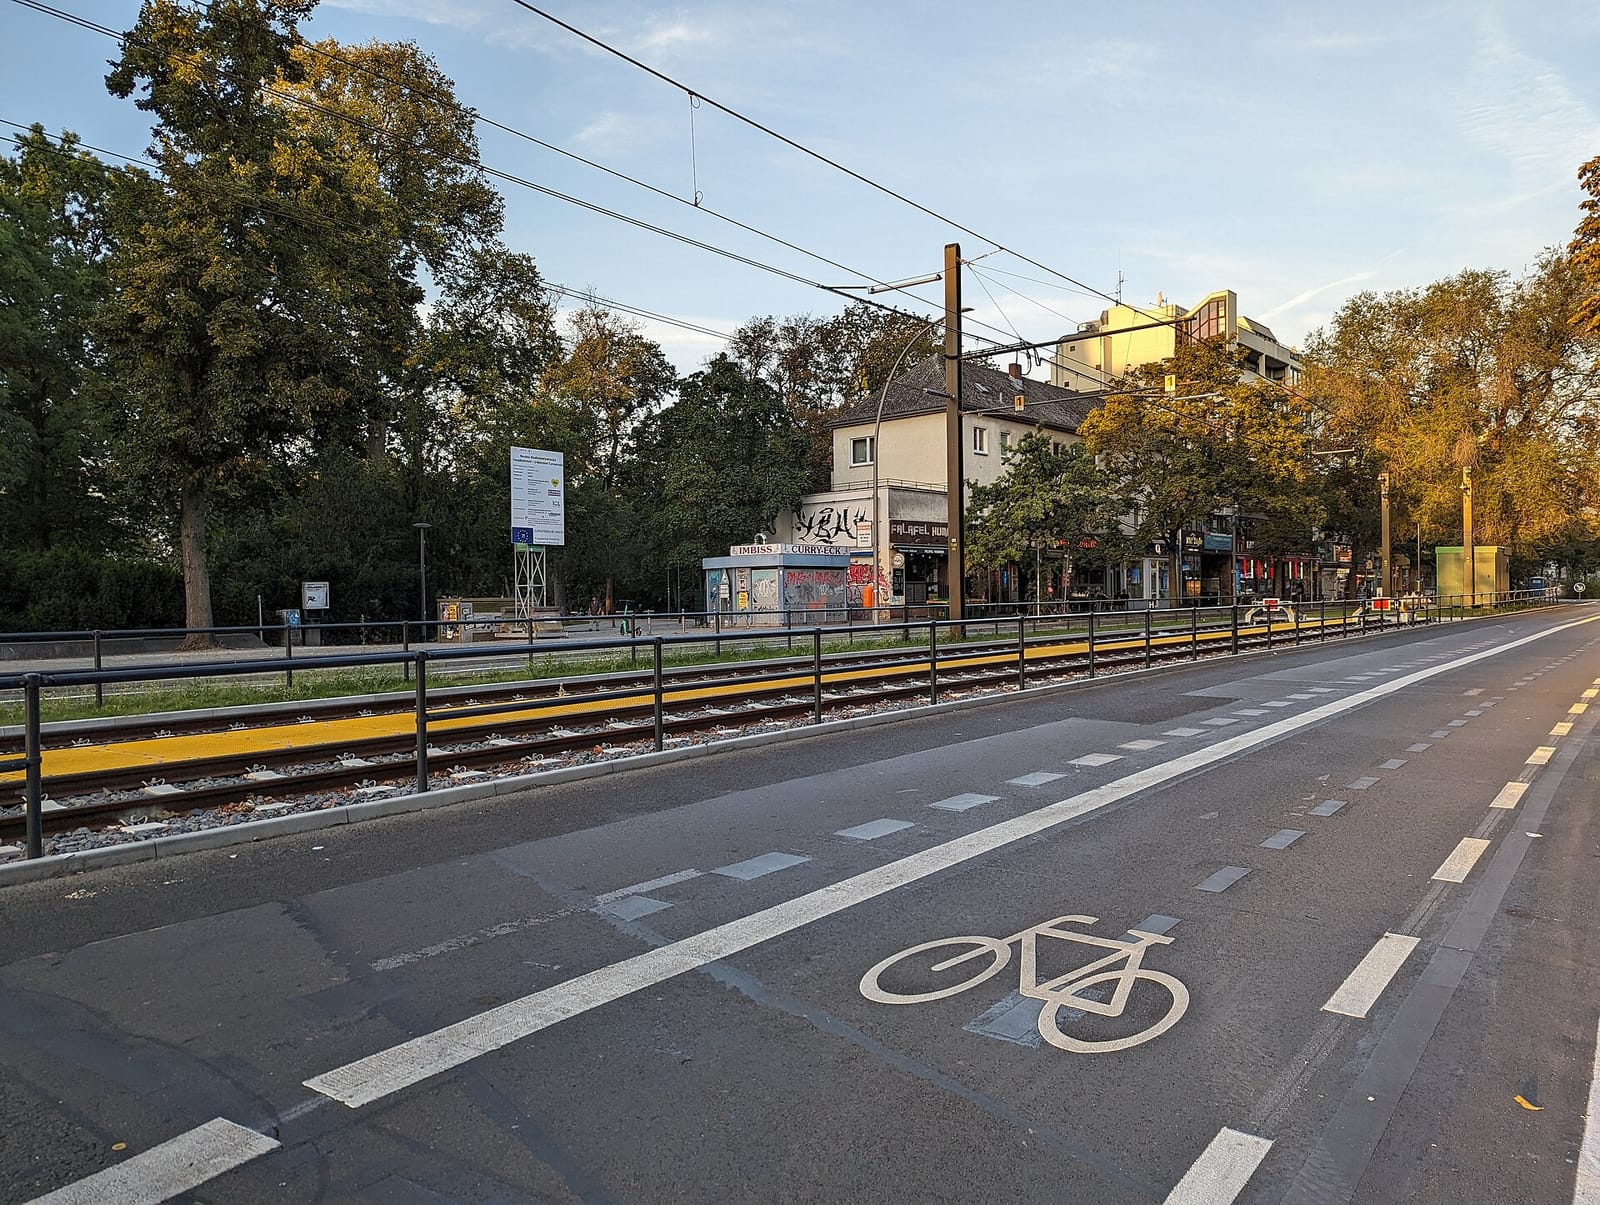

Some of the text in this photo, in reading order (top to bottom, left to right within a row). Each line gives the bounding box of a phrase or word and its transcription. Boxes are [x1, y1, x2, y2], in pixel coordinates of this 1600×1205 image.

[890, 523, 949, 538] FALAFEL HUM
[739, 545, 773, 554] IMBISS
[791, 545, 841, 555] CURRY-ECK
